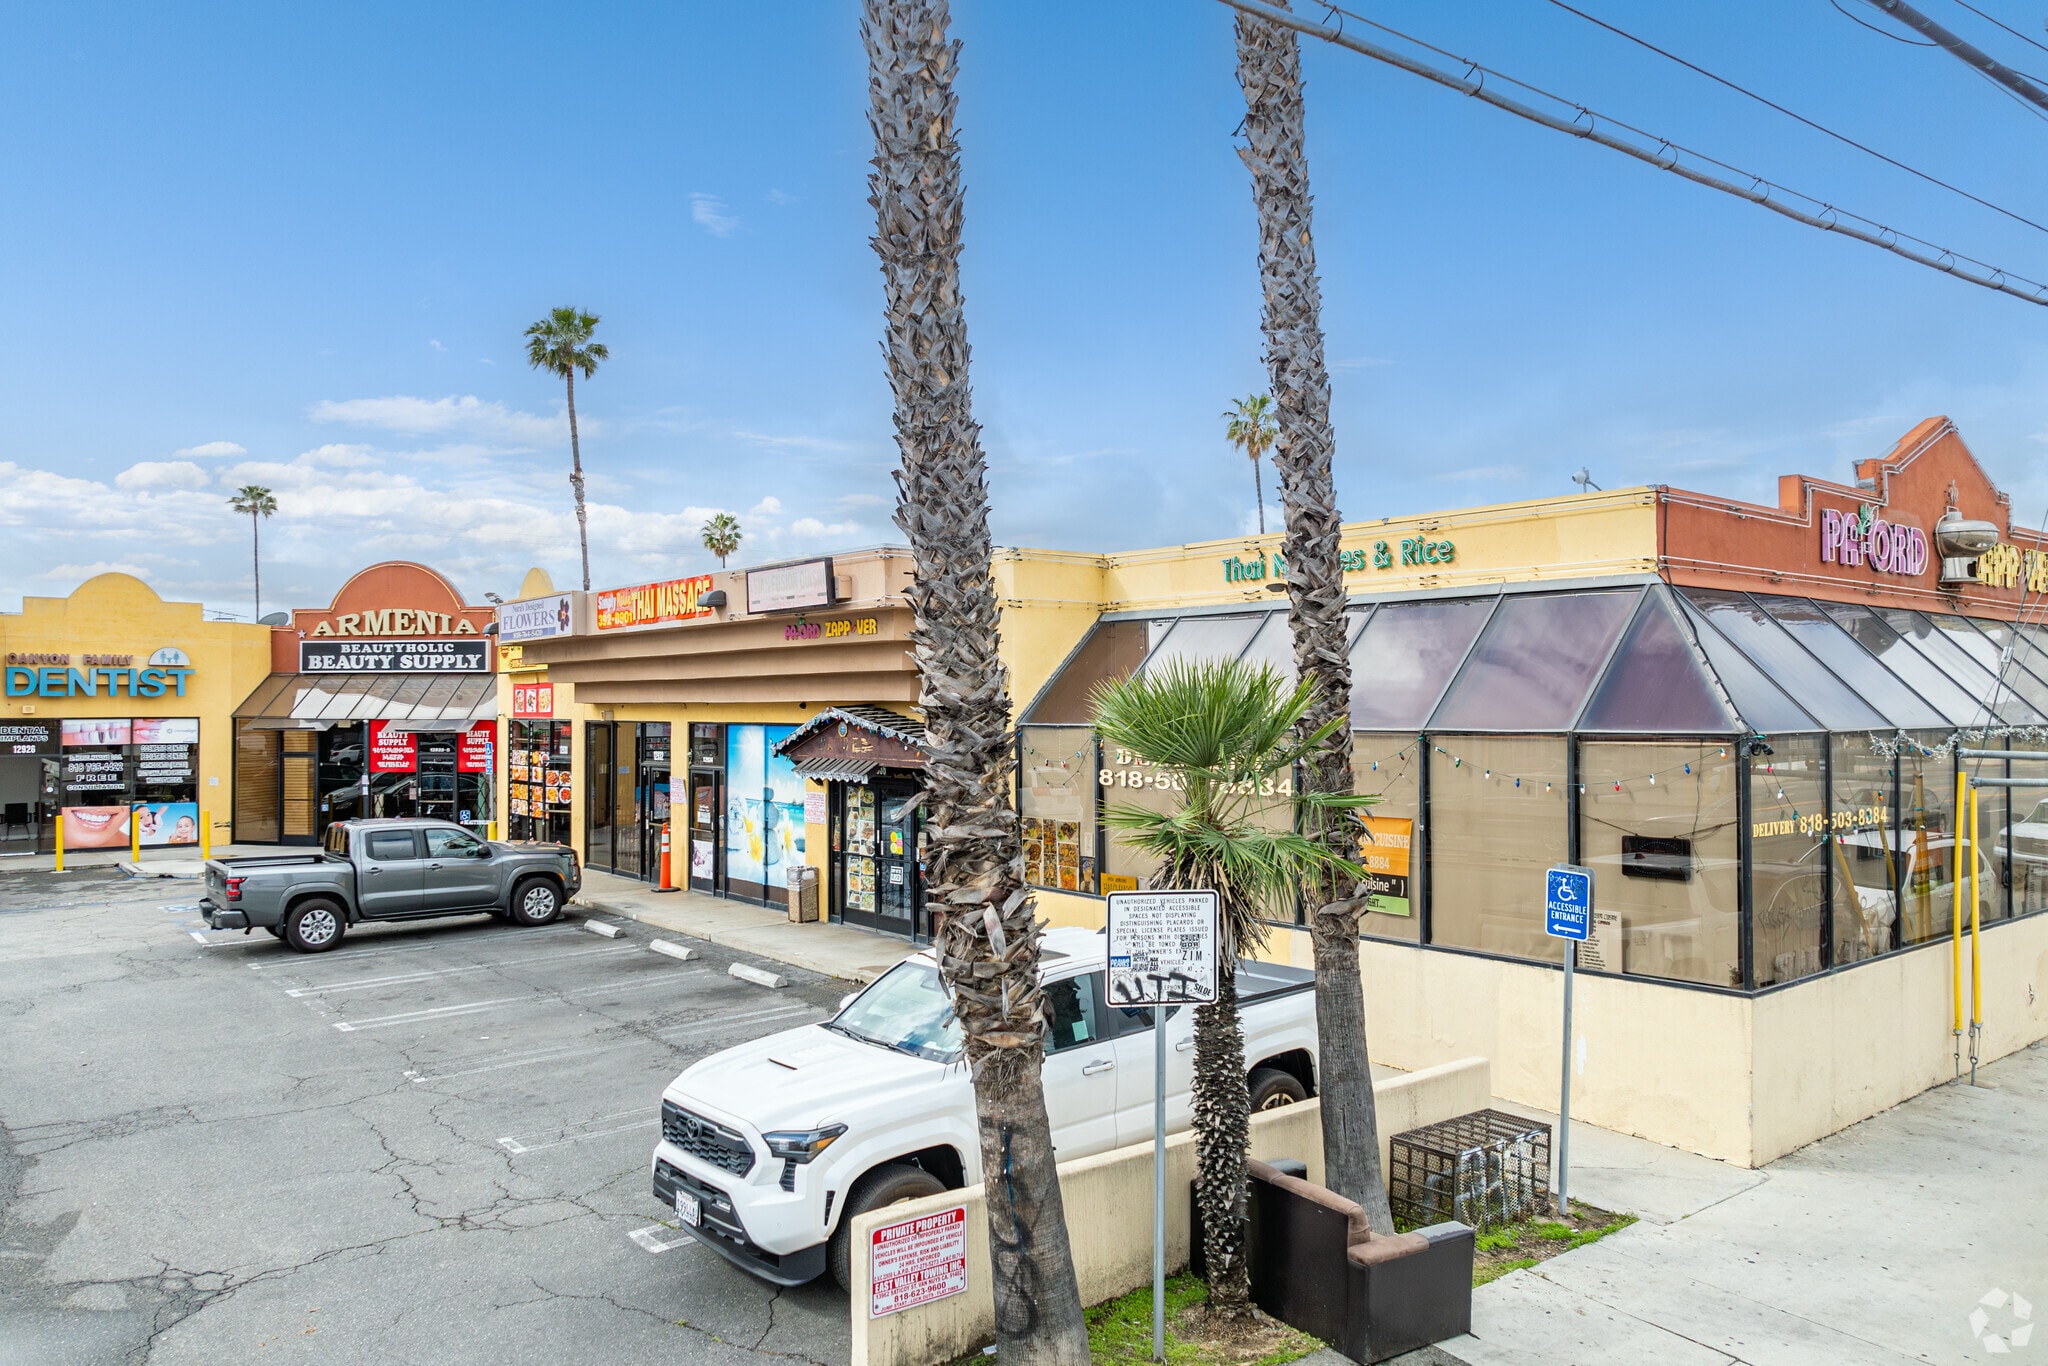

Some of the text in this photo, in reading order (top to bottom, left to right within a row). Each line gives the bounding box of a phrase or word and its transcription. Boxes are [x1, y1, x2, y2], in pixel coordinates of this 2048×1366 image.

[1221, 550, 1265, 583] Thai
[1372, 540, 1391, 569] &
[1400, 535, 1454, 566] Rice
[1976, 543, 2023, 588] APP
[631, 589, 655, 620] THAI
[656, 579, 711, 617] MASSAGE
[311, 608, 479, 637] ARMENIA
[503, 609, 555, 631] FLOWERS
[598, 610, 633, 627] 392-0901
[784, 618, 878, 640] PA-ORD ZAPP VER
[8, 652, 134, 666] CANYON FAMILY
[341, 643, 455, 654] BEAUTYHOLIC
[308, 654, 483, 670] BEAUTY SUPPLY
[5, 666, 196, 698] DENTIST
[0, 726, 49, 735] DENTAL
[466, 730, 490, 738] BEAUTY
[76, 774, 118, 782] FREE
[1753, 820, 1796, 838] DELIVERY
[1374, 832, 1410, 849] CUISINE
[1548, 901, 1587, 915] ACCESSIBLE
[1551, 911, 1584, 924] ENTRANCE
[1182, 950, 1202, 961] ZIM
[876, 1222, 961, 1250] UNAUTHORIZED OR IMPROPERLY PARKED
[881, 1211, 957, 1242] PRIVATE PROPERTY
[875, 1249, 897, 1260] VEHICLES
[914, 1237, 939, 1248] IMPOUNDED
[945, 1230, 963, 1240] VEHICLE
[878, 1256, 898, 1267] OWNER'S
[940, 1239, 960, 1250] LIABILITY
[917, 1251, 941, 1264] ENFORCED
[874, 1259, 963, 1293] EAST VALLEY TOWING INC.
[890, 1285, 910, 1296] SATICOY
[928, 1276, 941, 1284] NUYS
[881, 1304, 893, 1312] JUMP
[893, 1300, 908, 1308] START
[936, 1288, 947, 1296] FLAT
[894, 1281, 947, 1303] 818-623-9600
